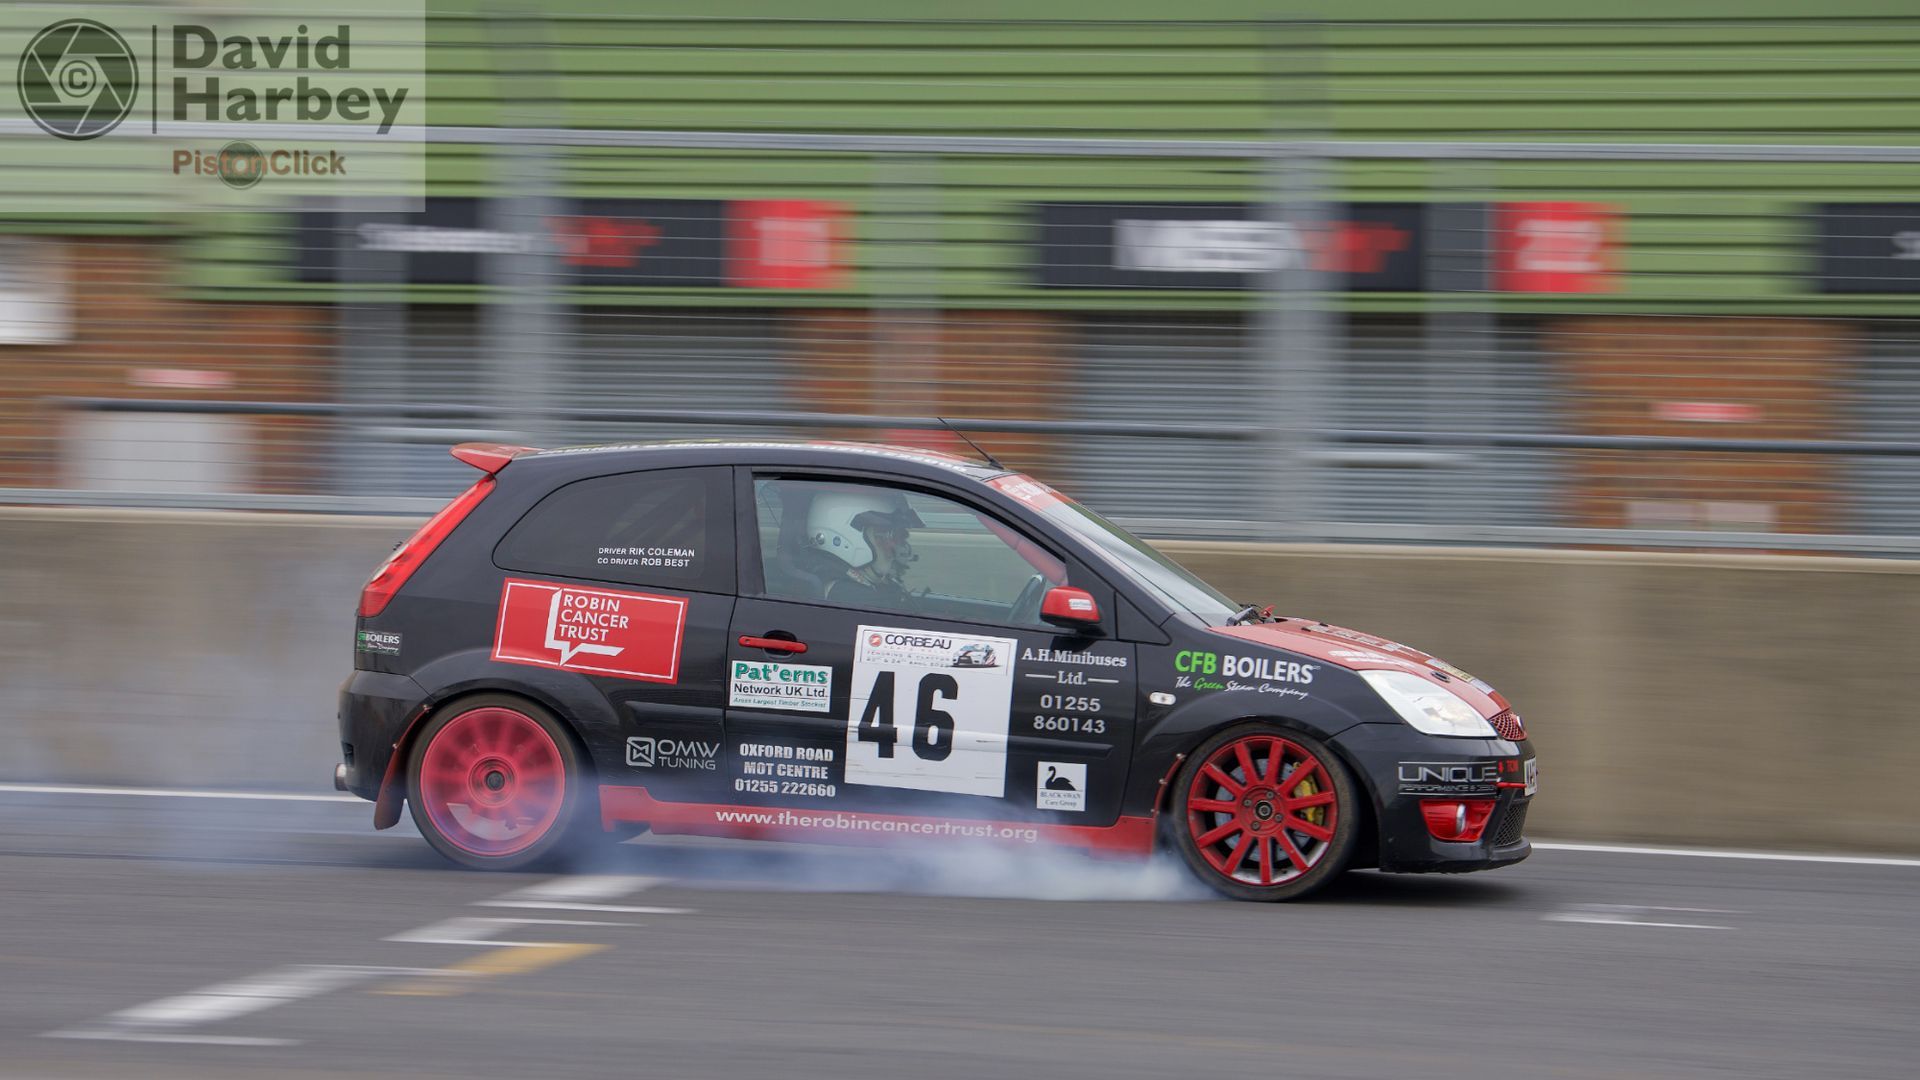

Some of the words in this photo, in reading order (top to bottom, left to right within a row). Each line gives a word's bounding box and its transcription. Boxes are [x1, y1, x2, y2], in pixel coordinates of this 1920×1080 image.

[598, 547, 627, 555] DRIVER
[629, 547, 645, 556] RIK
[647, 548, 695, 557] COLEMAN
[640, 558, 662, 566] ROB
[664, 558, 690, 567] BEST
[563, 594, 620, 612] ROBIN
[561, 609, 629, 629] CANCER
[559, 623, 609, 641] TRUST
[885, 634, 952, 650] CORBEAU
[735, 662, 829, 684] Pat'erns
[1175, 650, 1217, 674] CFB
[1222, 655, 1313, 684] BOILERS
[1057, 670, 1087, 685] Ltd.
[734, 683, 782, 695] Network
[785, 686, 803, 697] UK
[1175, 676, 1192, 688] The
[1193, 677, 1225, 691] Green
[1258, 683, 1308, 700] Company
[1040, 694, 1101, 712] 01255
[857, 671, 958, 762] 46
[1033, 715, 1106, 734] 860143
[657, 739, 720, 758] OMW
[739, 743, 793, 759] OXFORD
[795, 747, 834, 762] ROAD
[658, 756, 716, 771] TUNING
[743, 761, 774, 775] MOT
[777, 764, 829, 780] CENTRE
[1398, 766, 1497, 782] UNIQUE
[734, 778, 778, 794] 01255
[781, 781, 836, 797] 222660
[715, 809, 1038, 844] www.therobincancertrust.org
